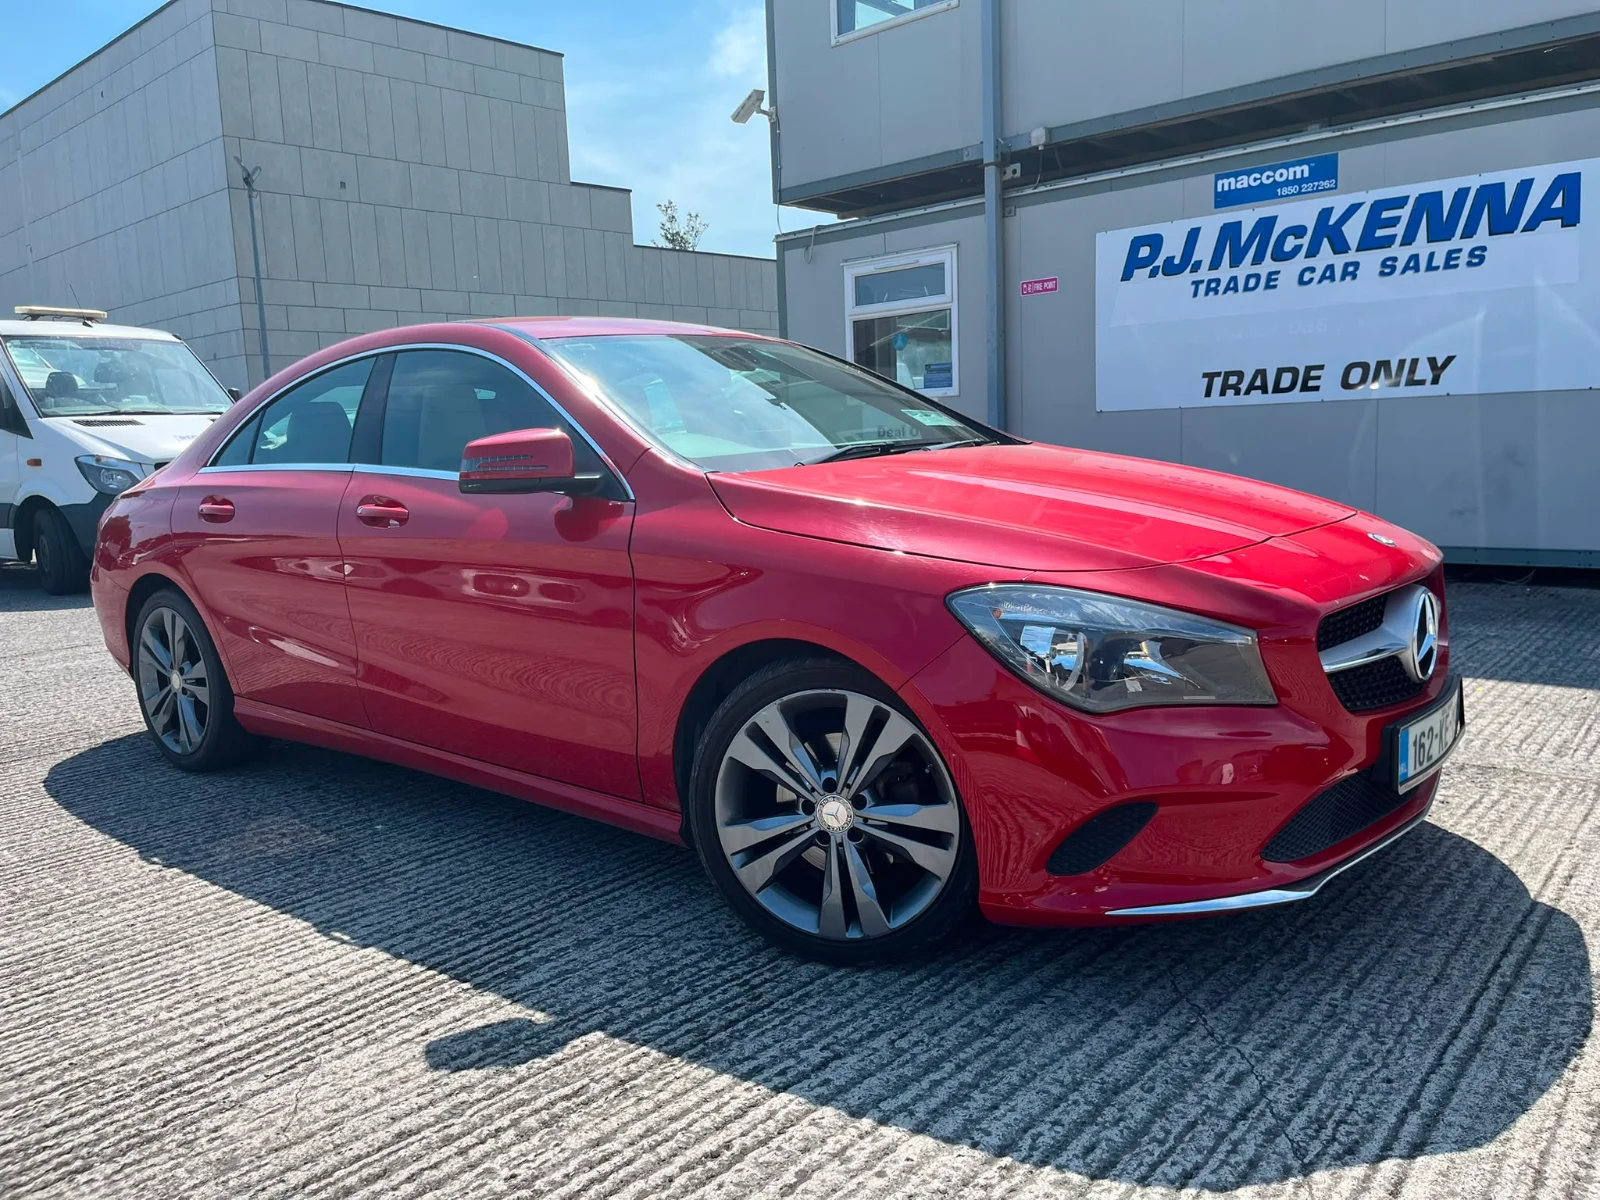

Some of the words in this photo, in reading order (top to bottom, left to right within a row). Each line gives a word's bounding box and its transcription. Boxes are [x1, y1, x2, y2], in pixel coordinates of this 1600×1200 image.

[1216, 164, 1309, 192] maccom
[1276, 185, 1300, 196] 1850
[1301, 179, 1337, 192] 227262
[1190, 270, 1281, 298] TRADE
[1297, 260, 1360, 287] CAR
[1378, 245, 1488, 278] SALES
[1202, 364, 1325, 398] TRADE
[1340, 355, 1457, 390] ONLY
[877, 426, 905, 438] Deal
